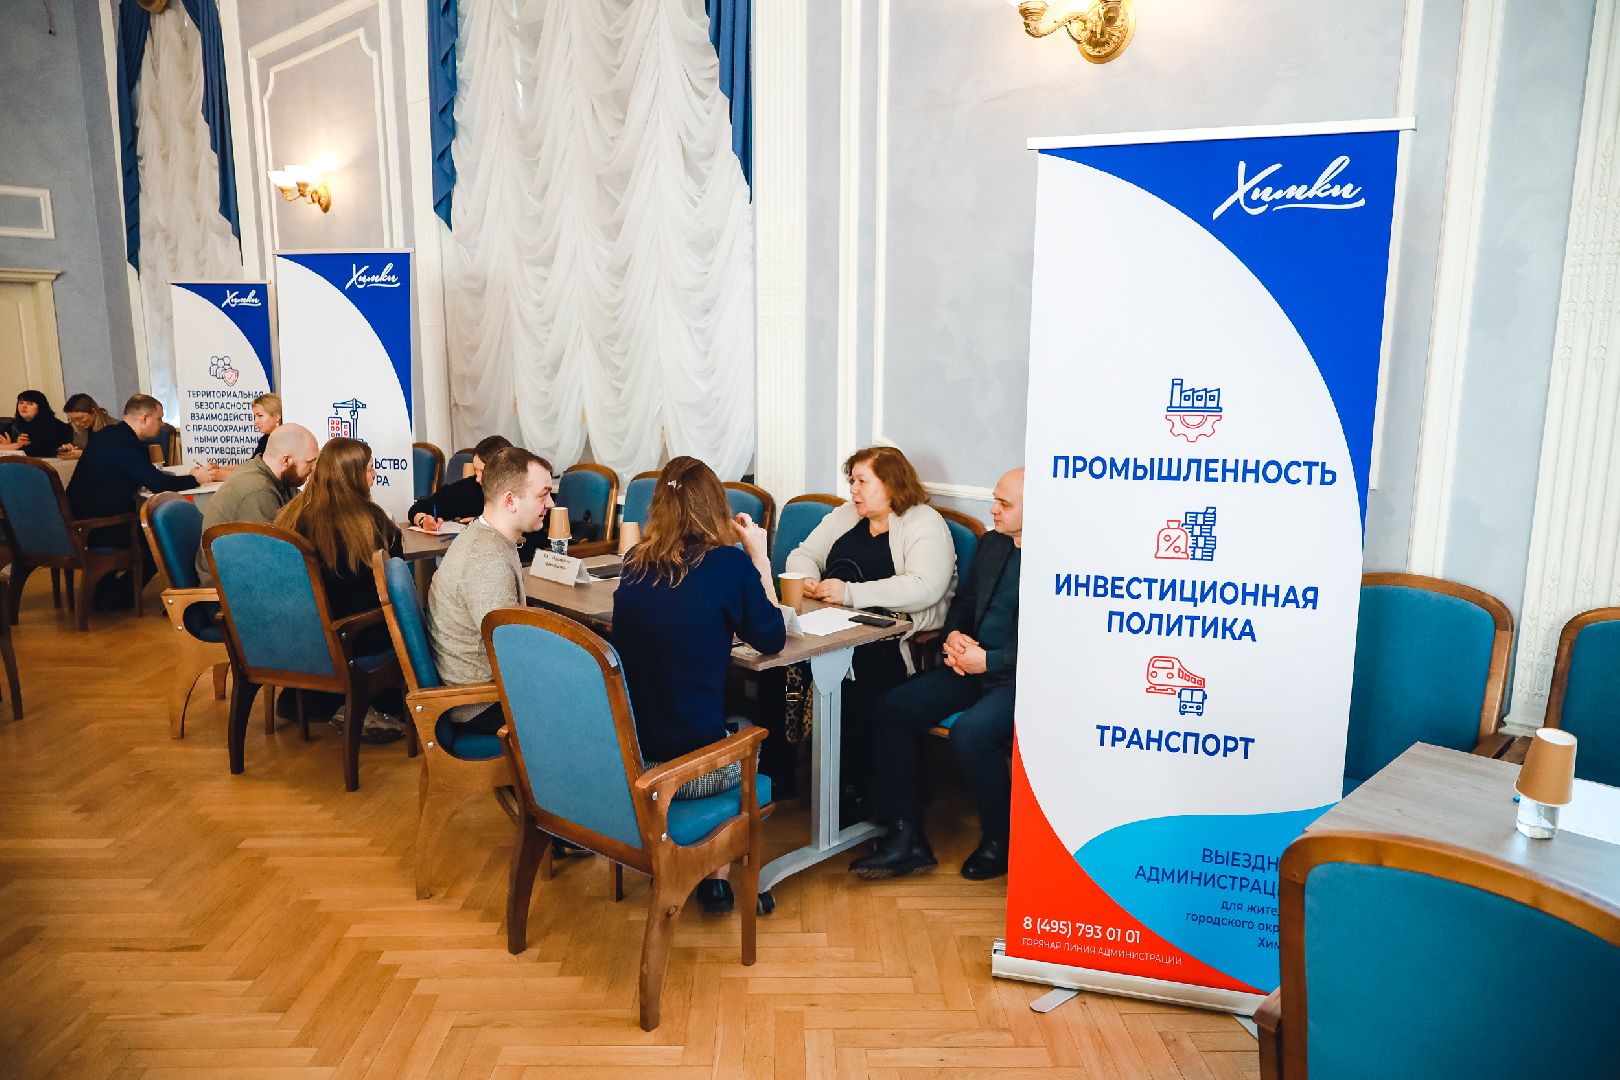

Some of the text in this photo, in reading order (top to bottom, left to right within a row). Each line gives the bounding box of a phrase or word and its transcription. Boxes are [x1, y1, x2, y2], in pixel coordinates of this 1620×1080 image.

[1212, 155, 1366, 221] Химки
[344, 262, 401, 291] Химки
[187, 390, 264, 400] ТЕРРИТОРИАЛЬНАЯ
[194, 401, 251, 410] БЕЗОПАСНОСТ
[185, 424, 260, 433] С ПРАВООХРАНИТЕ
[190, 411, 256, 422] ВЗАИМОДЕЙСТВ
[187, 445, 256, 456] И ПРОТИВОДЕЙСТ
[194, 435, 219, 443] НЫМИ
[1052, 456, 1337, 486] ПРОМЫШЛЕННОСТЬ
[1055, 573, 1319, 610] ИНВЕСТИЦИОННАЯ
[1107, 610, 1257, 643] ПОЛИТИКА
[1095, 724, 1256, 760] ТРАНСПОРТ
[1201, 847, 1280, 873] ВЫЕЗДН
[1134, 865, 1276, 900] АДМИНИСТРАЦ
[1220, 900, 1280, 917] для жите
[1022, 915, 1141, 944] 8 (495) 793 01 01
[1186, 912, 1280, 936] городского окр
[1022, 937, 1183, 966] ГОРЯЧАЯ ЛИНИЯ АДМИНИСТРАЦИИ
[1257, 936, 1280, 950] Хим
